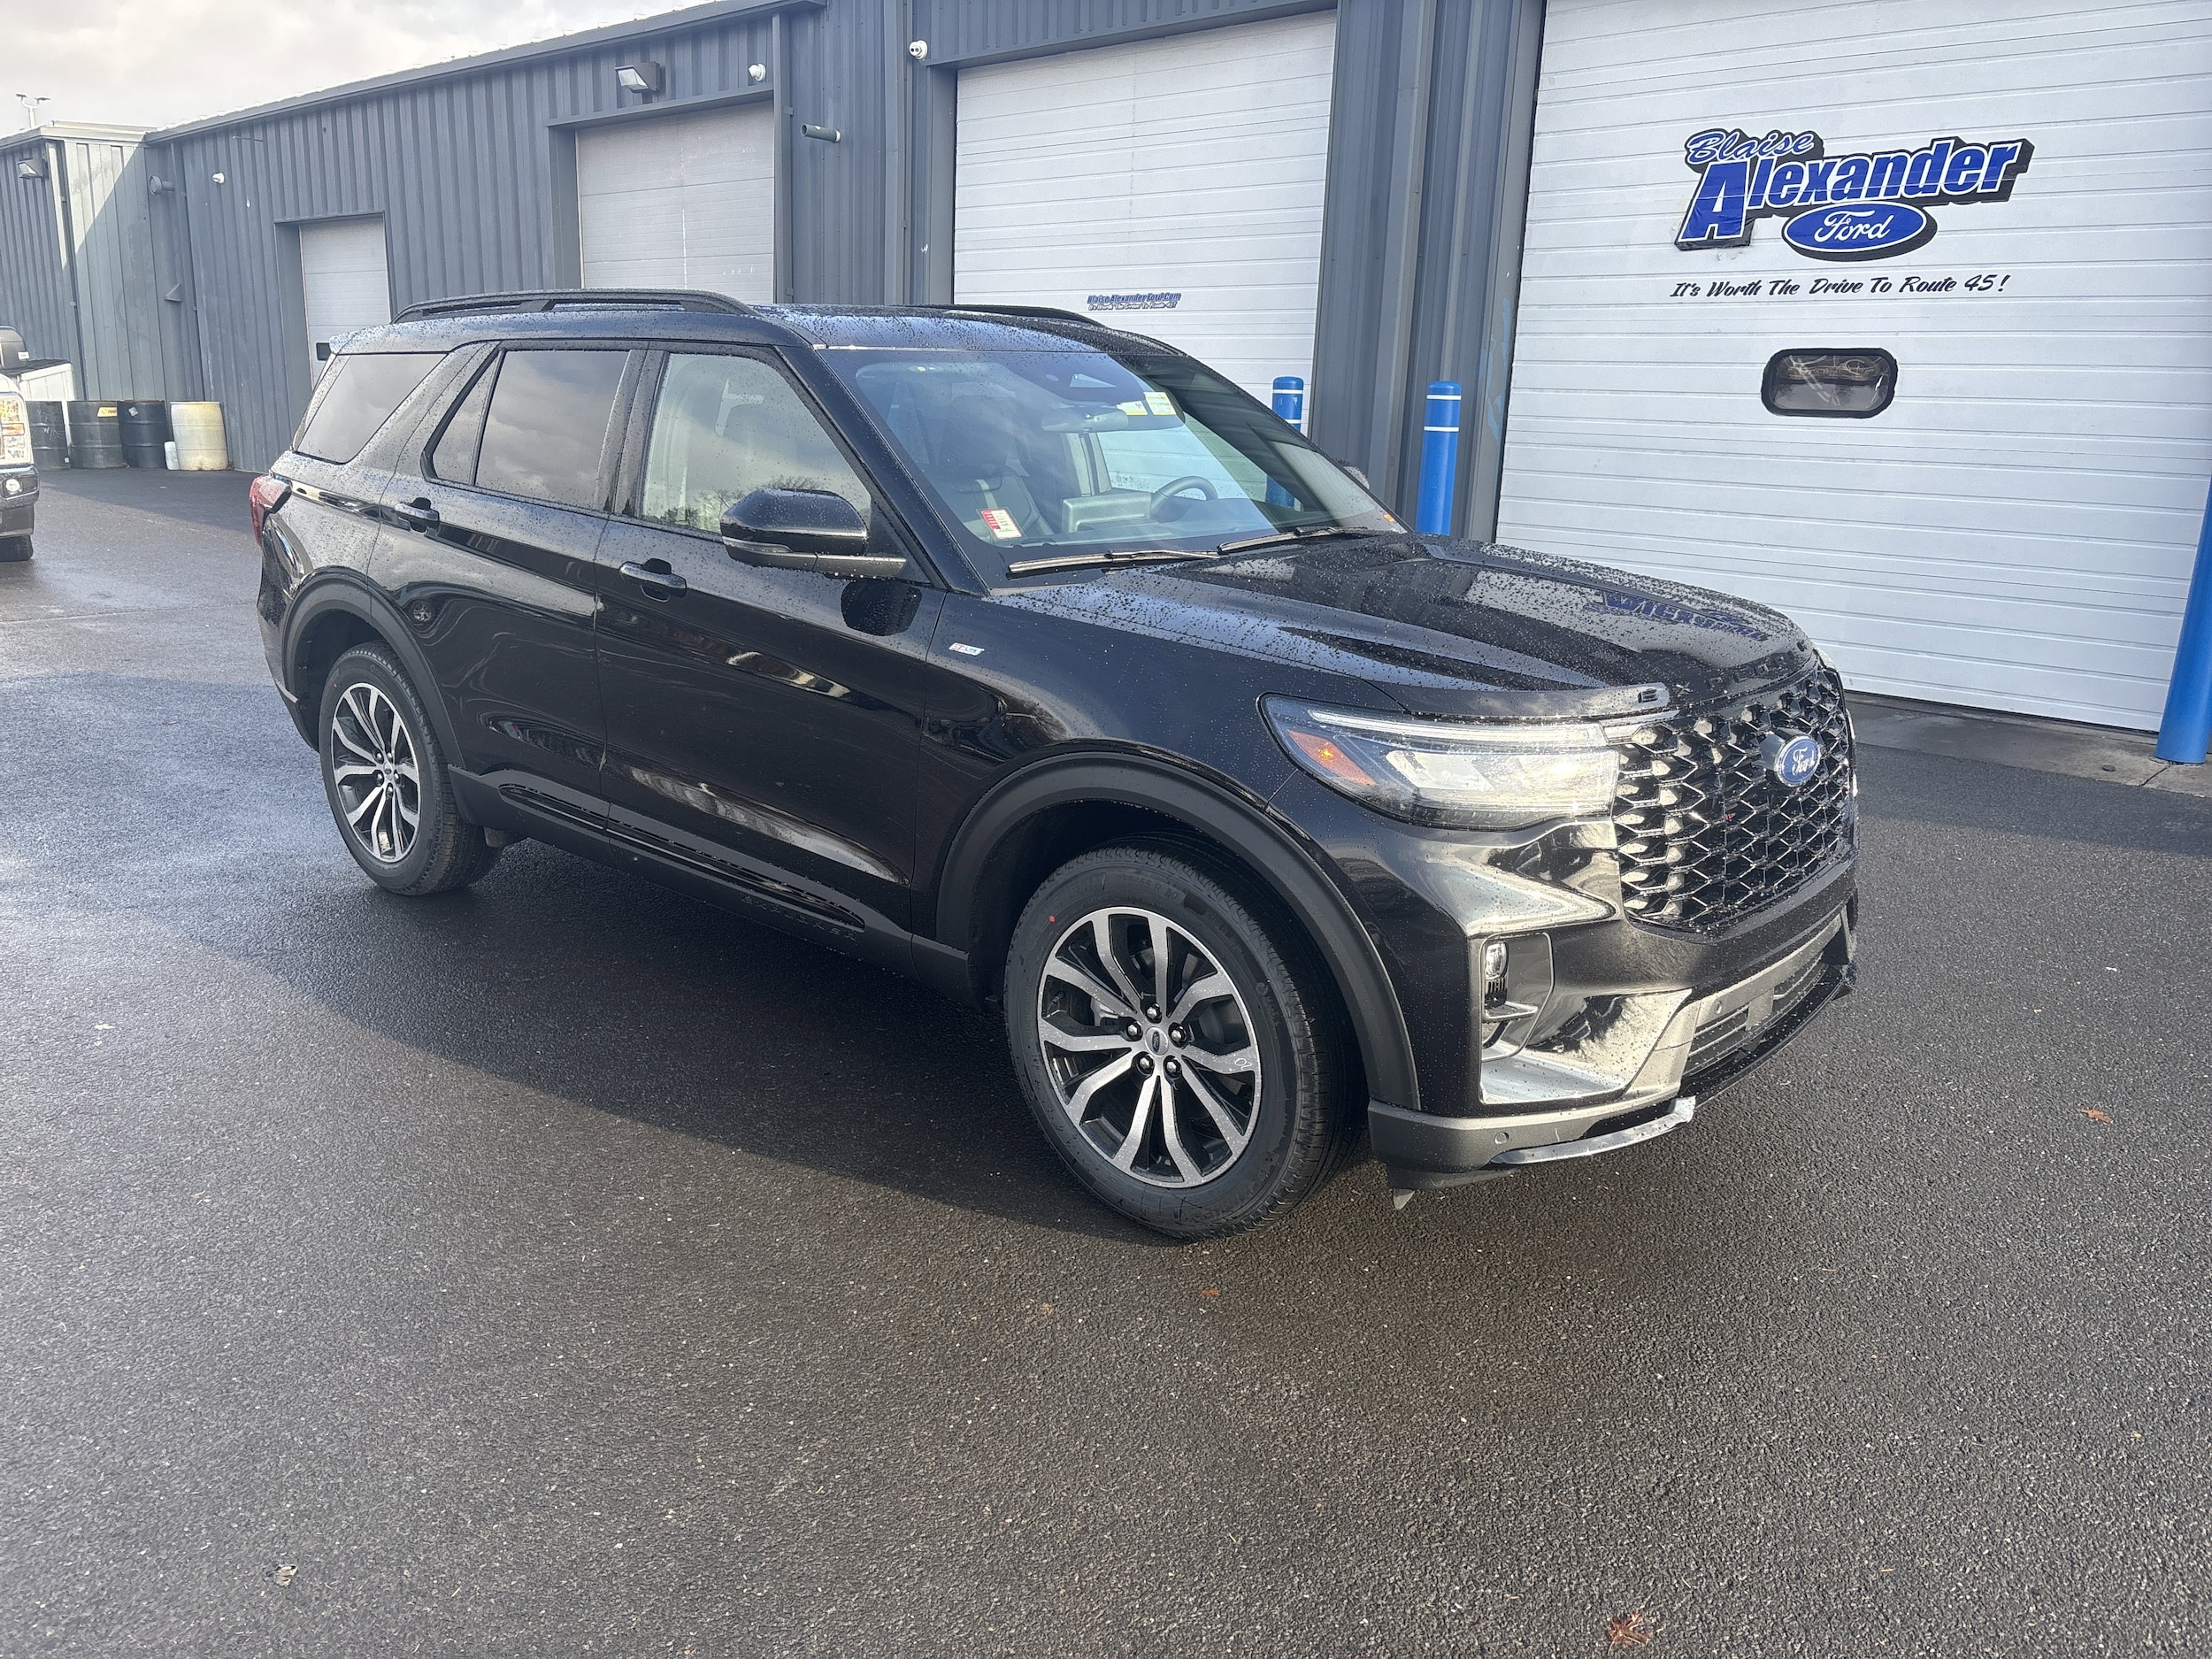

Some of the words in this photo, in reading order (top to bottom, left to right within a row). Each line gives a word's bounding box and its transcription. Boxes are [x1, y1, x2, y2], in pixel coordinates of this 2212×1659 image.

[1687, 130, 1814, 164] Blaise
[1678, 138, 2024, 243] Alexander
[1814, 210, 1893, 242] Ford
[1669, 282, 1701, 297] It's
[1706, 280, 1763, 297] Worth
[1769, 279, 1801, 296] The
[1809, 278, 1864, 295] Drive
[1870, 276, 1893, 294] To
[1898, 276, 1958, 293] Route
[1791, 746, 1816, 776] Ford
